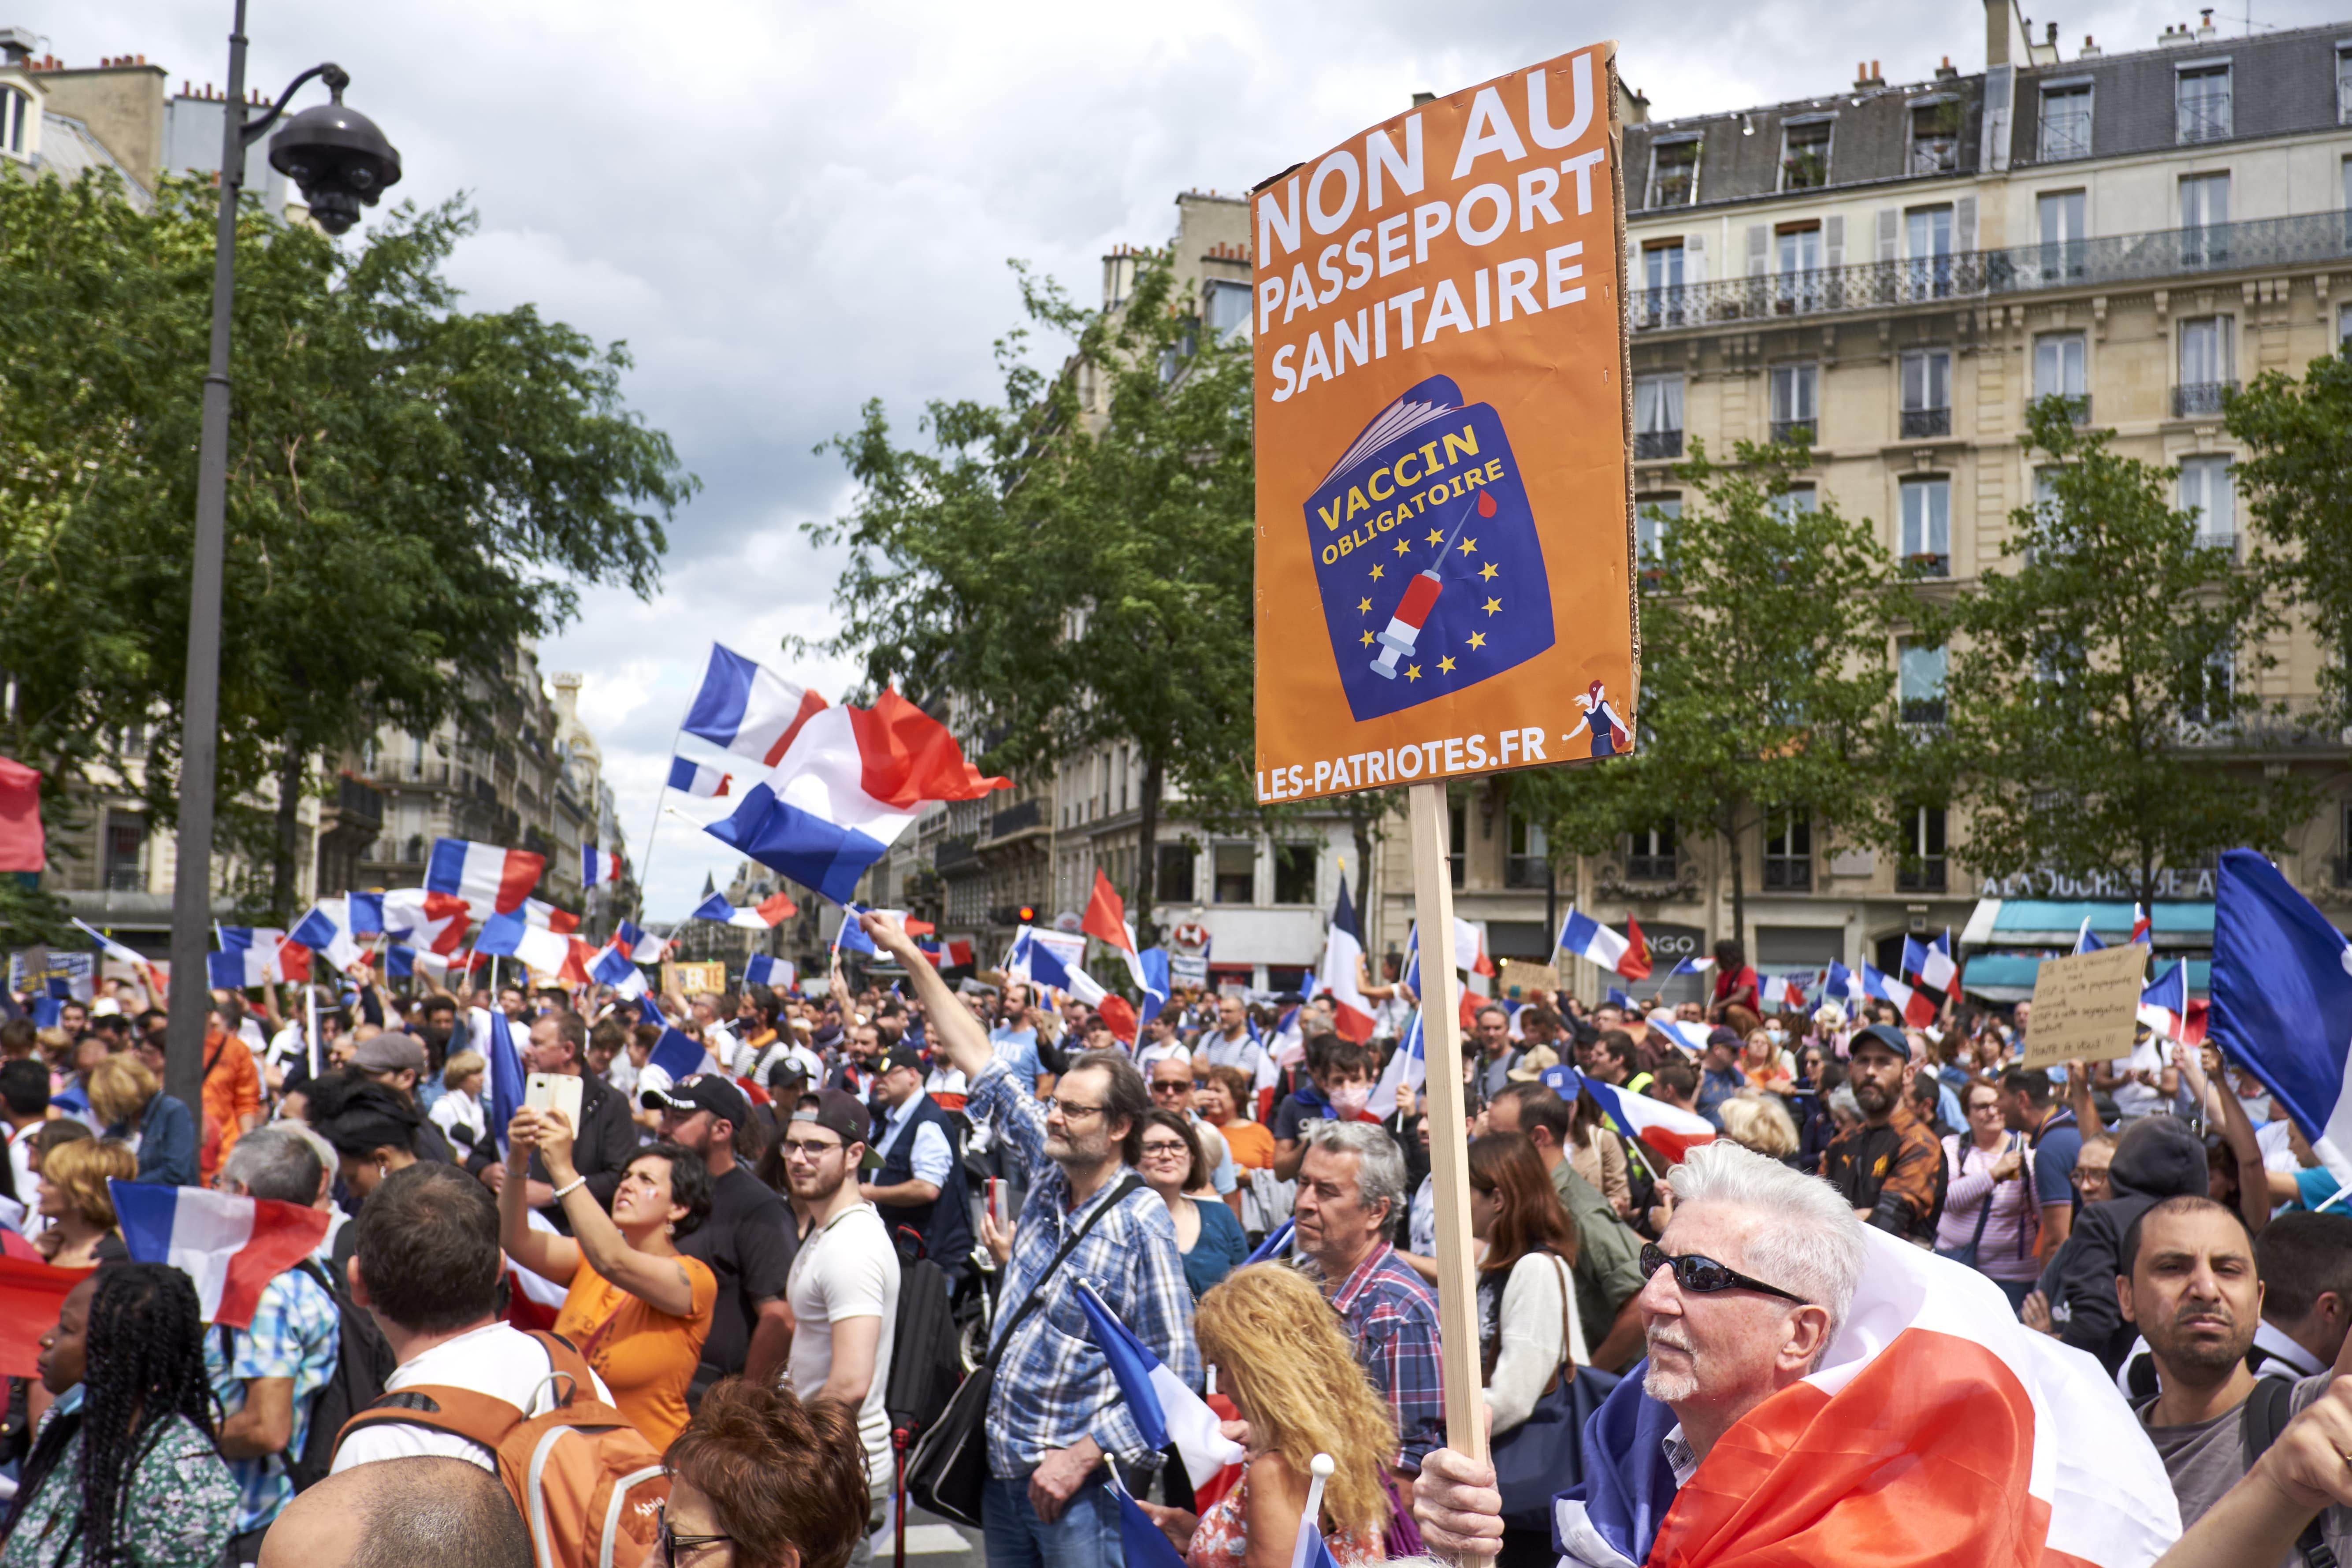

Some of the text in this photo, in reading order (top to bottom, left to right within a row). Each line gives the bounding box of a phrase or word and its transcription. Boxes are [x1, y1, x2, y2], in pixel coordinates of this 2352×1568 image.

[1258, 52, 1593, 269] NON AU
[1259, 148, 1604, 334] PASSEPORT
[1271, 241, 1586, 401] SANITAIRE
[1317, 424, 1479, 532] VACCIN
[1322, 458, 1505, 565] OBLIGATOIRE
[1257, 727, 1546, 801] LES-PATRIOTES.FR
[1643, 935, 1695, 954] NGO
